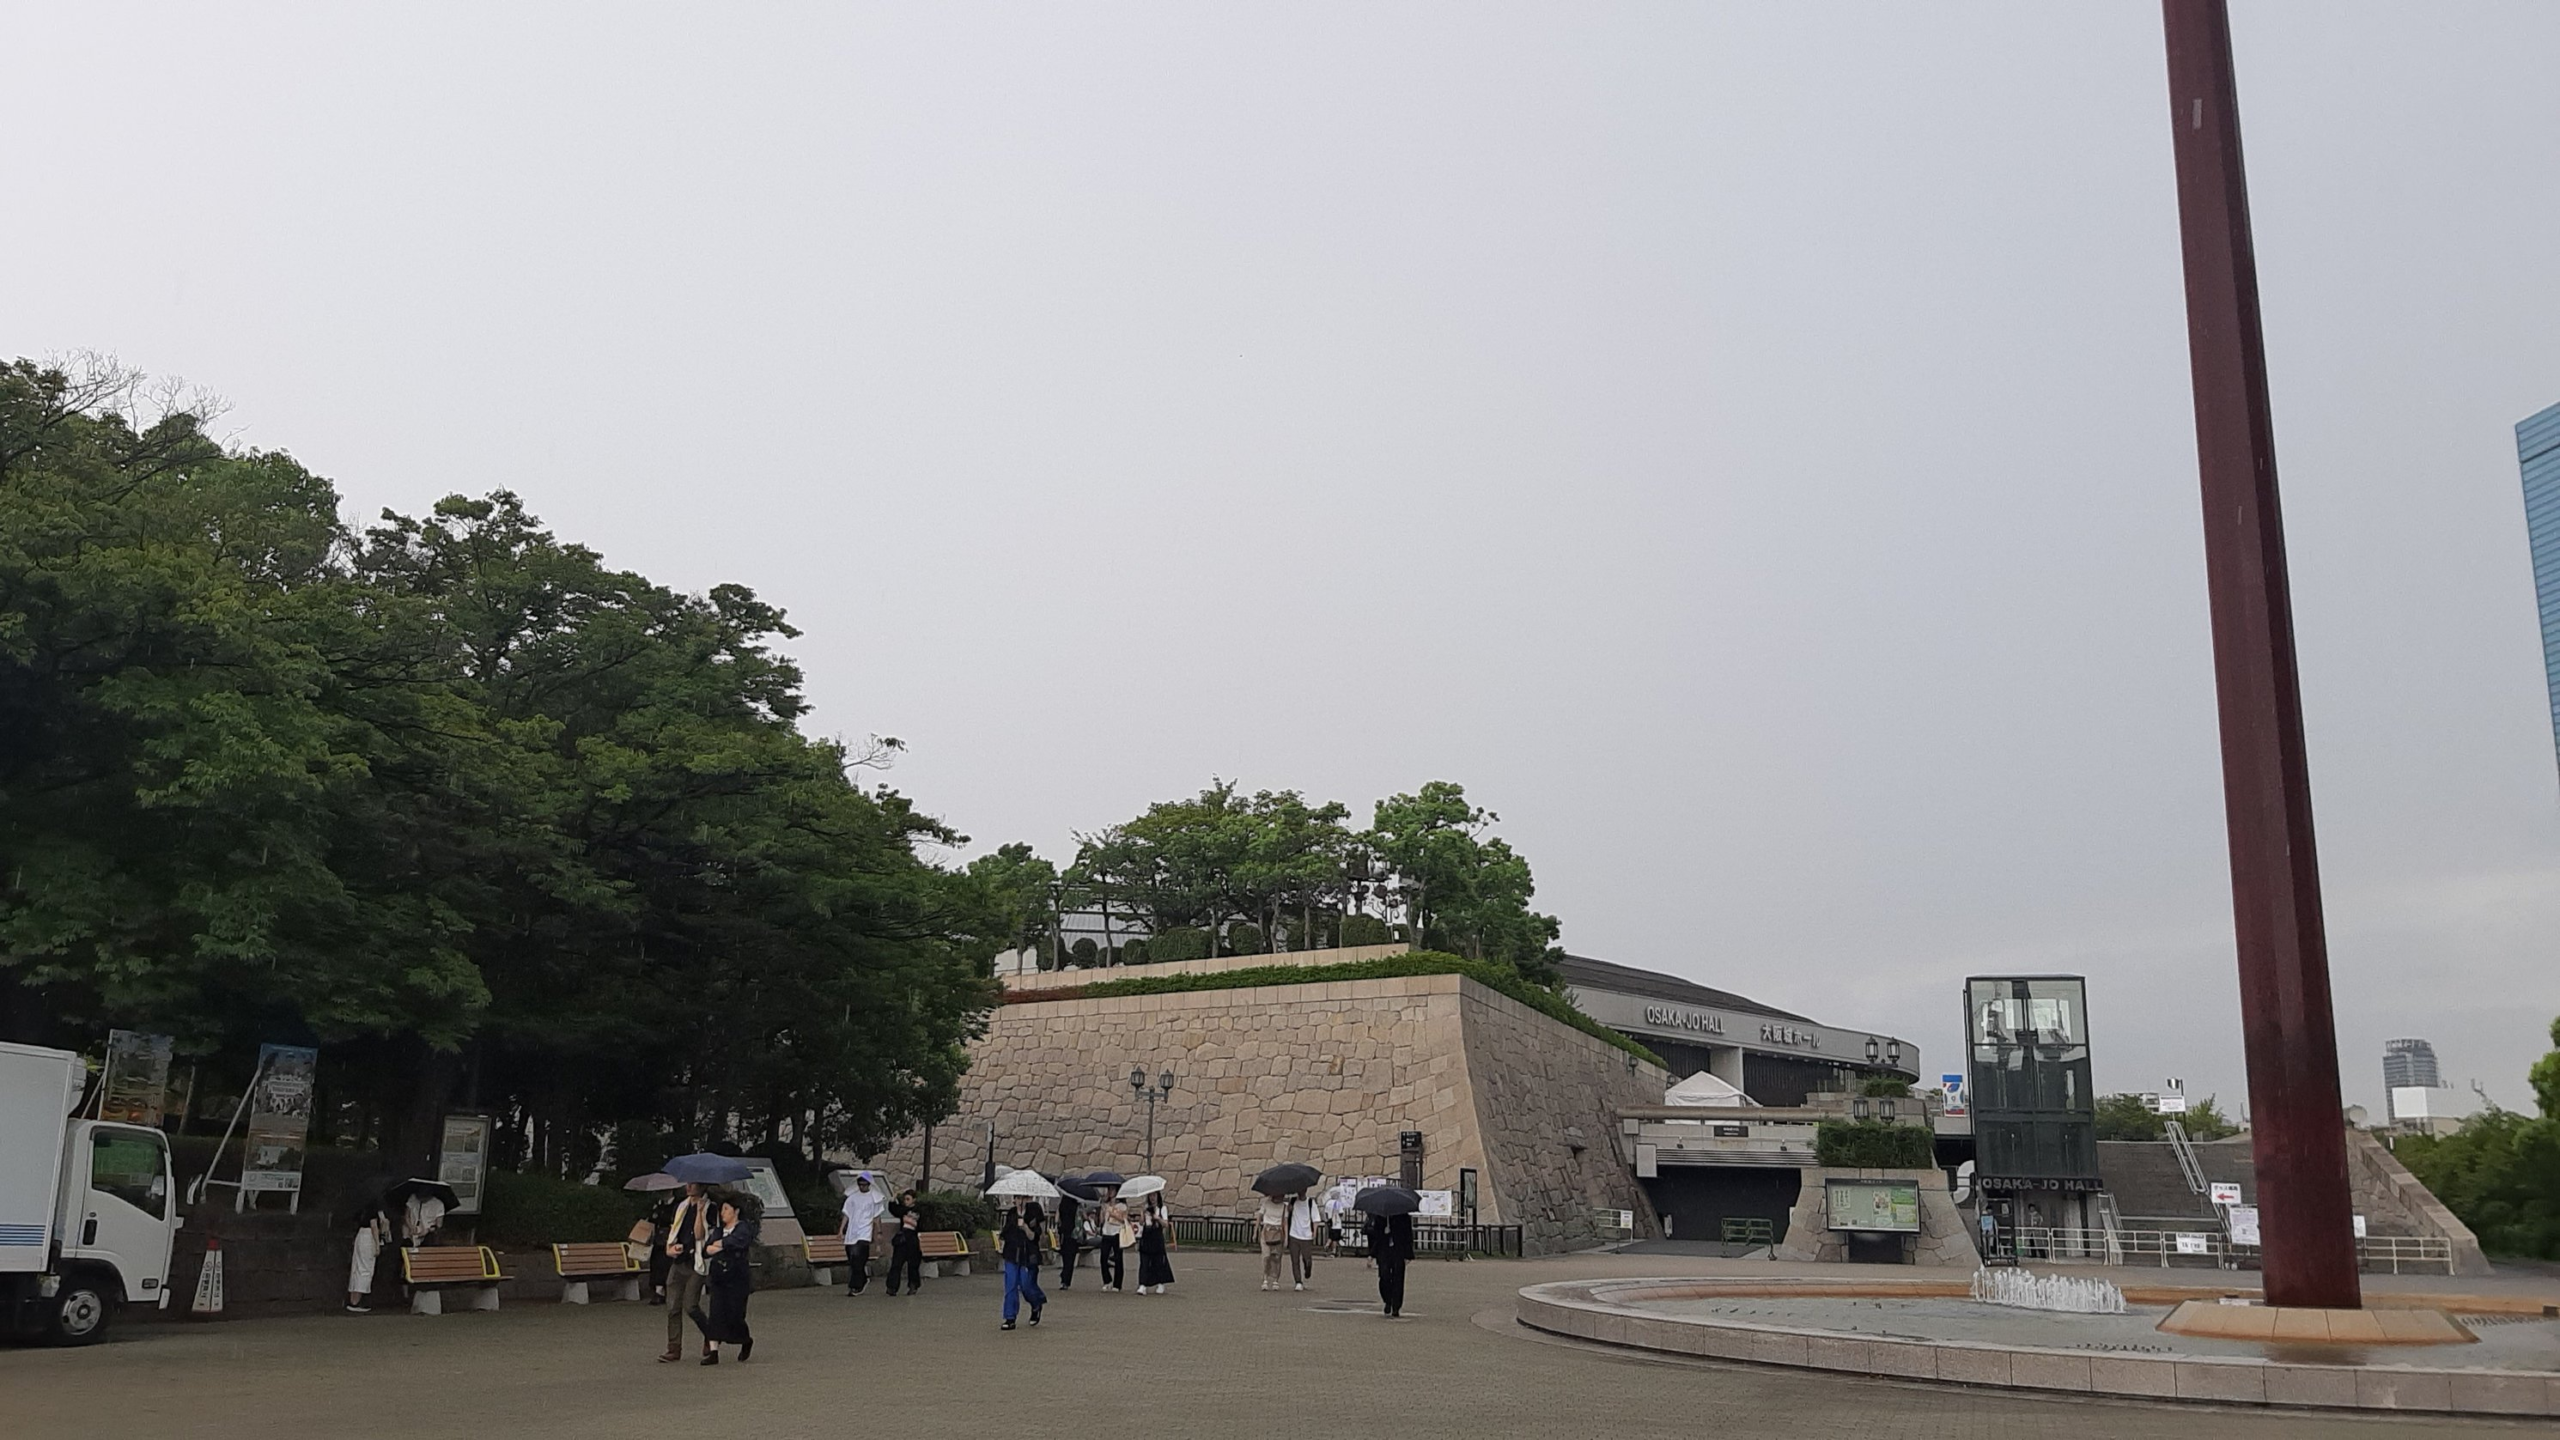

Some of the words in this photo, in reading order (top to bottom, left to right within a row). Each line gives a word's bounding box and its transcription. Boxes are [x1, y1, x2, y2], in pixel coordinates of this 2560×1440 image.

[1646, 1005, 1700, 1030] OSAKA-JO
[1701, 1013, 1726, 1034] HALL
[1761, 1023, 1822, 1048] 大阪城ホール
[1982, 1177, 2060, 1190] OSAKA-JO
[2064, 1179, 2103, 1191] HALL
